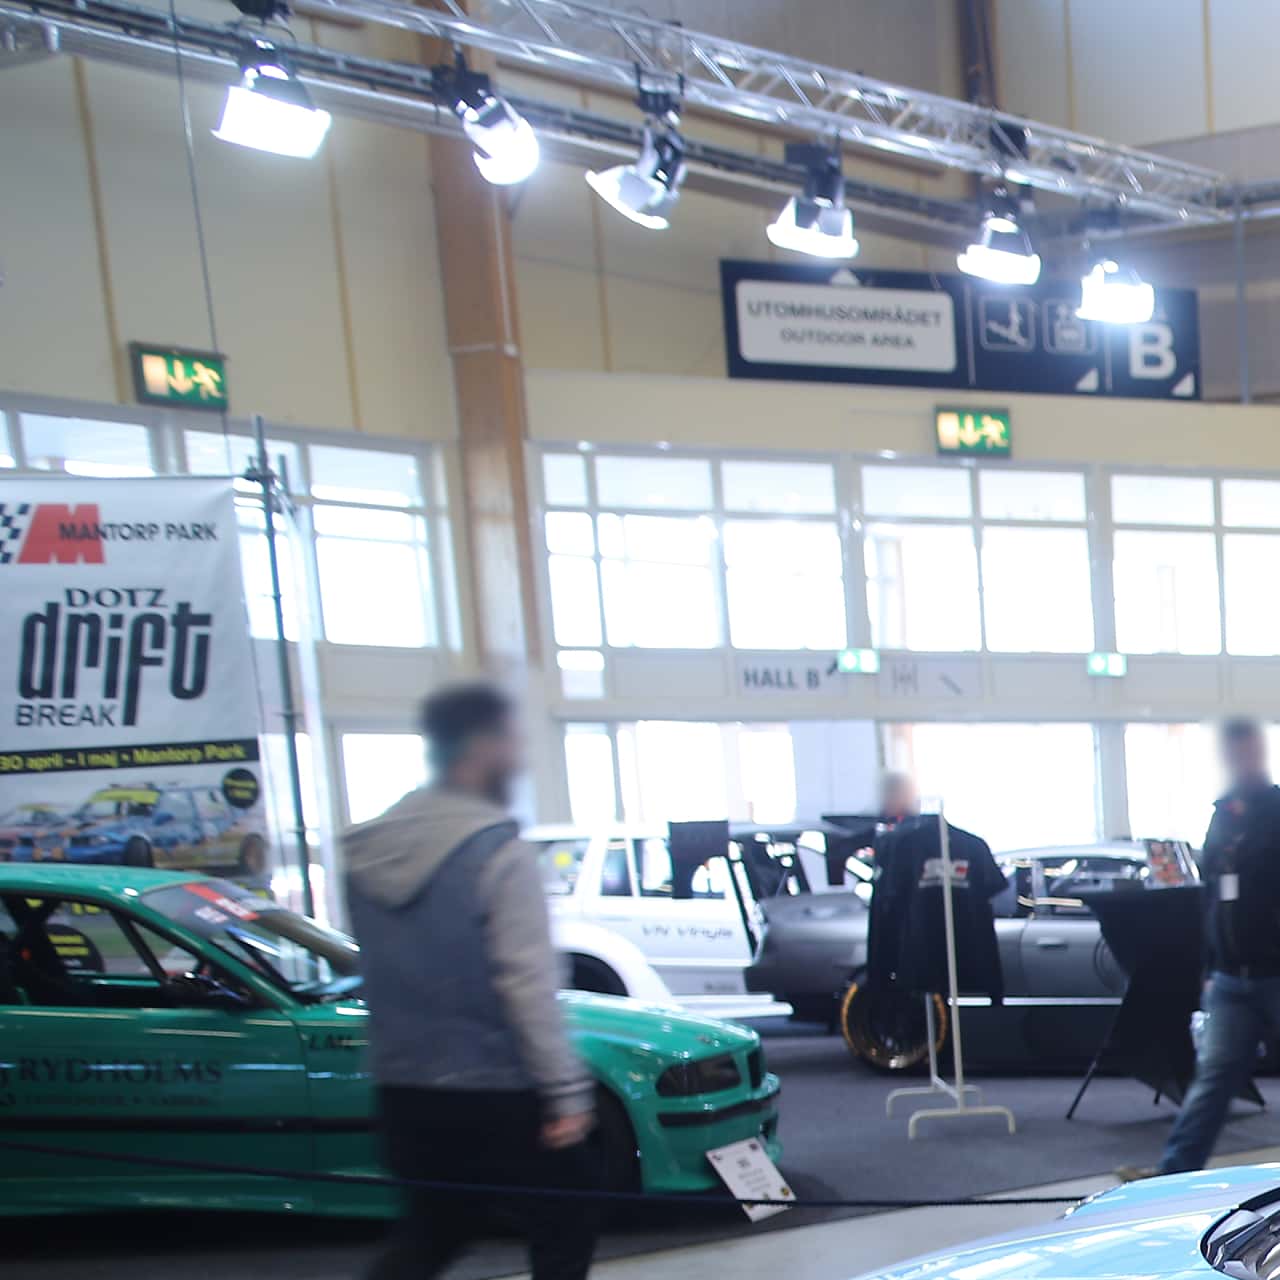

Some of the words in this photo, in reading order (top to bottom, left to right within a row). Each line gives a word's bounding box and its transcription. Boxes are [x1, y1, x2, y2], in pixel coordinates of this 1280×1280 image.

[781, 326, 866, 346] OUTDOOR
[871, 333, 917, 350] AREA
[1129, 321, 1177, 379] B
[58, 521, 160, 542] MANTORP
[164, 521, 218, 542] PARK
[65, 588, 168, 610] DOTZ
[18, 601, 212, 727] drift
[744, 668, 797, 689] HALL
[806, 668, 820, 689] B
[16, 704, 118, 727] BREAK
[18, 1057, 222, 1085] RYDHOLMS
